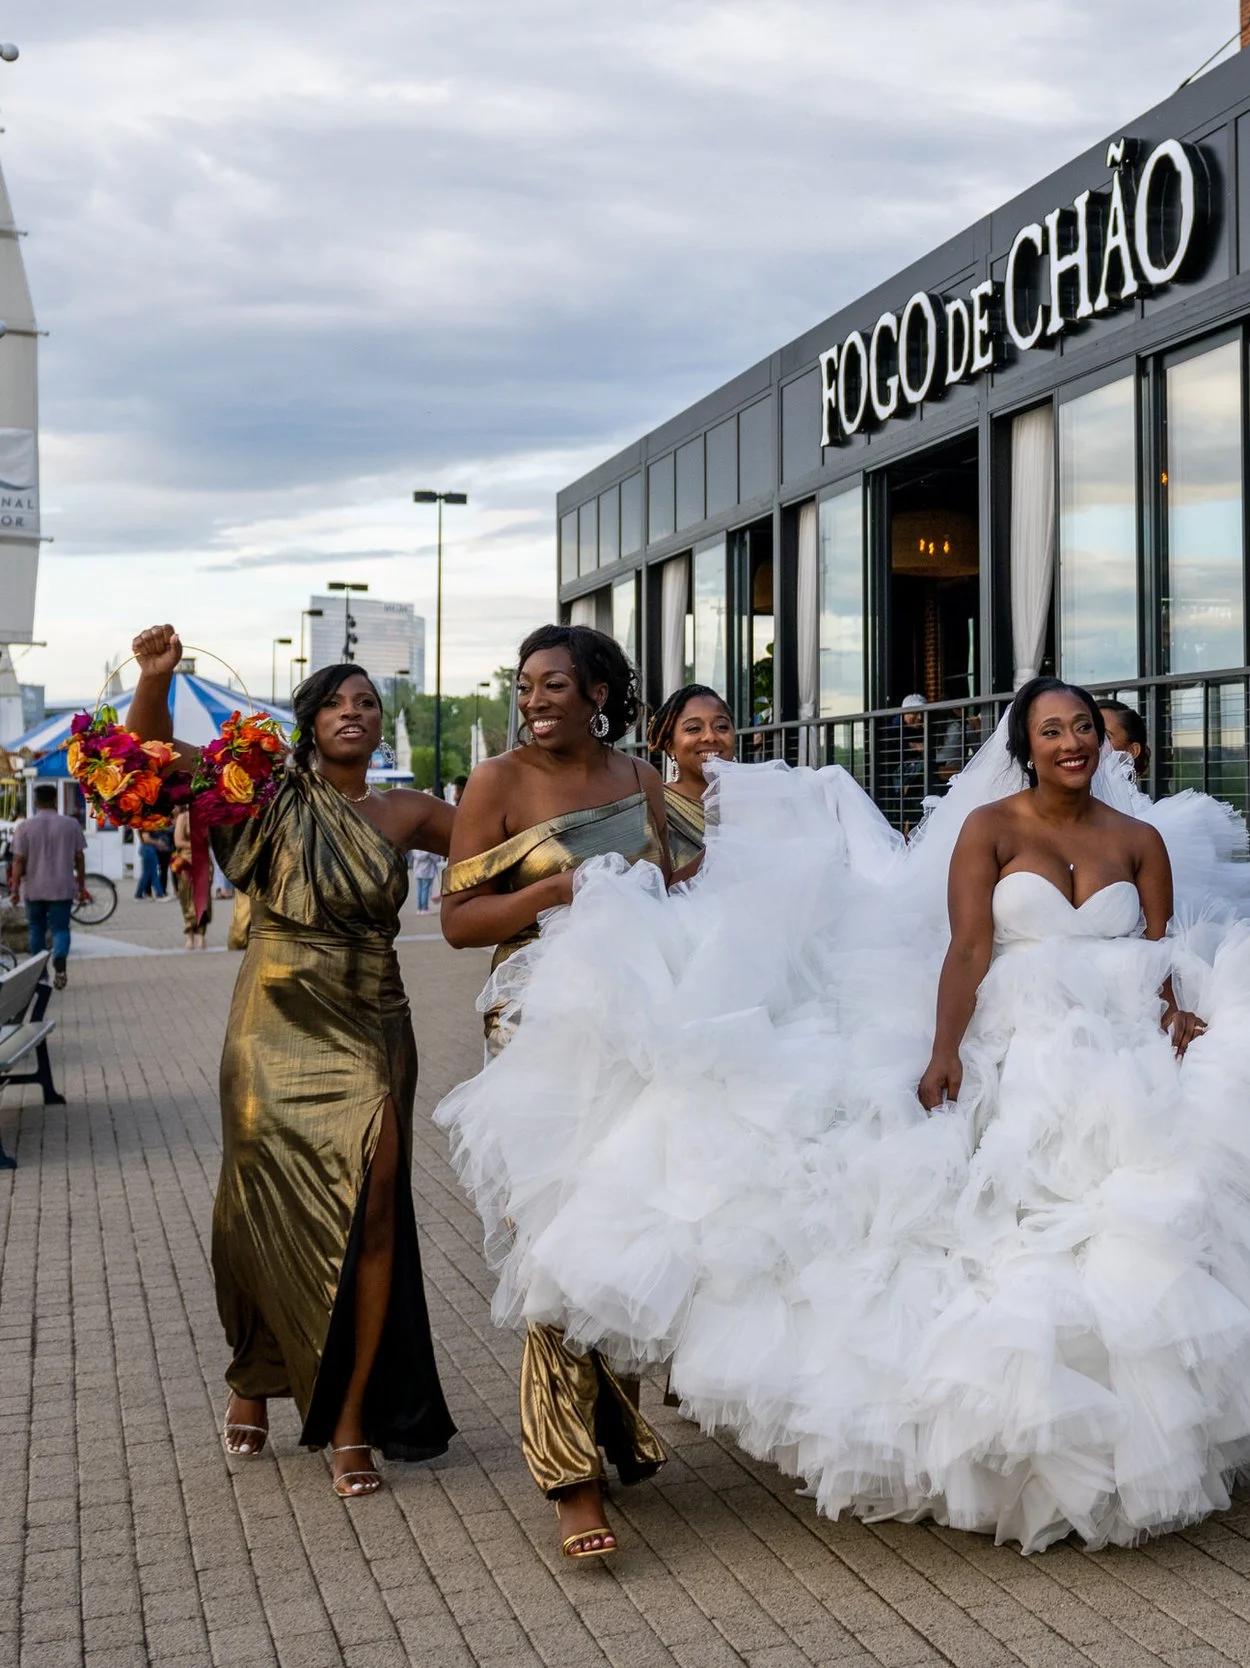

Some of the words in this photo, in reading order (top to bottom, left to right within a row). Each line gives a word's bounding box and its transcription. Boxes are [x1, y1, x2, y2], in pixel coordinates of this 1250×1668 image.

[818, 291, 937, 447] FOGO
[944, 279, 994, 386] DE
[1004, 137, 1195, 350] CHÃO
